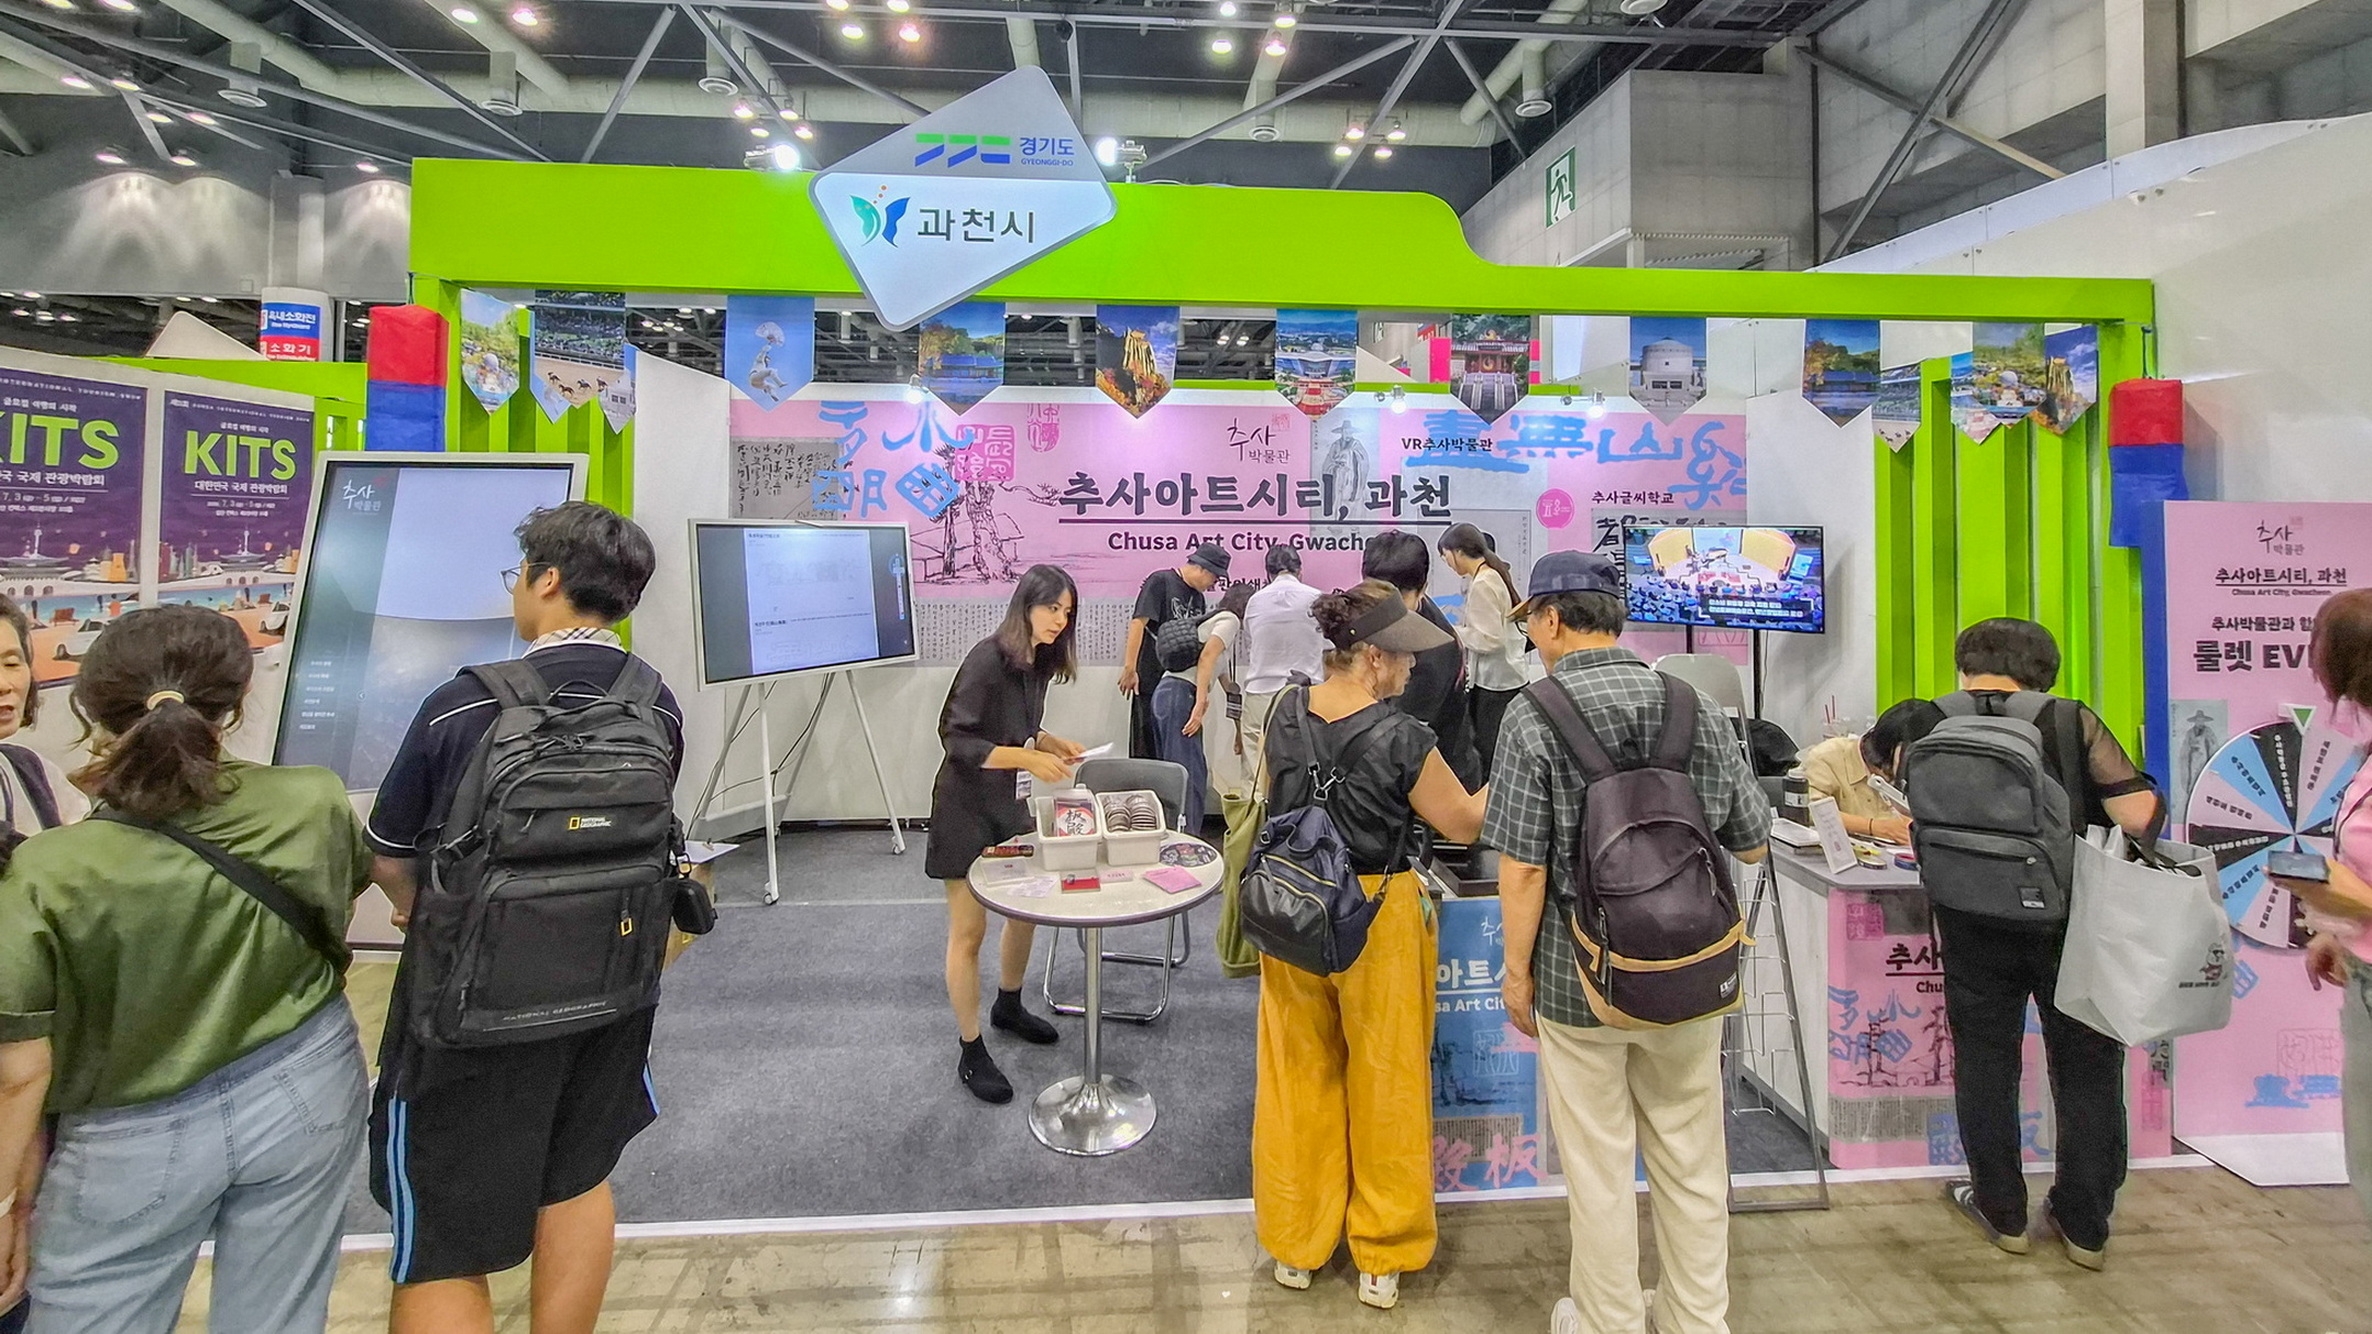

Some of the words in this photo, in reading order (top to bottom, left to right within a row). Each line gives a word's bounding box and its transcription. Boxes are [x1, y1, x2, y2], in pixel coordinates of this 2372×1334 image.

[1019, 137, 1075, 156] 경기도
[1020, 159, 1074, 167] GYEONGGI-DO
[917, 208, 1036, 244] 과천시
[270, 343, 311, 355] 소화기
[1226, 417, 1277, 461] 추사
[1401, 437, 1494, 452] VR추사박물관
[184, 430, 297, 480] KITS
[1248, 448, 1291, 464] 박물관
[0, 469, 13, 483] 국
[195, 480, 229, 492] 대한민국
[342, 480, 375, 511] 추사
[1058, 471, 1349, 521] 추사아트시티,
[1364, 474, 1452, 518] 과천
[1591, 490, 1675, 505] 추사글씨학교
[353, 500, 382, 512] 박물관
[1108, 531, 1178, 551] Chusa
[1185, 533, 1224, 551] Art
[2256, 520, 2294, 553] 추사
[2273, 543, 2305, 556] 박물관
[2215, 567, 2313, 585] 추사아트시티,
[2317, 567, 2347, 584] 과천
[2257, 588, 2271, 596] Art
[2211, 616, 2295, 632] 추사박물관과
[2193, 640, 2253, 672] 룰렛
[1886, 943, 1941, 971] 추사
[1916, 980, 1943, 993] Chu
[1454, 998, 1481, 1012] Art
